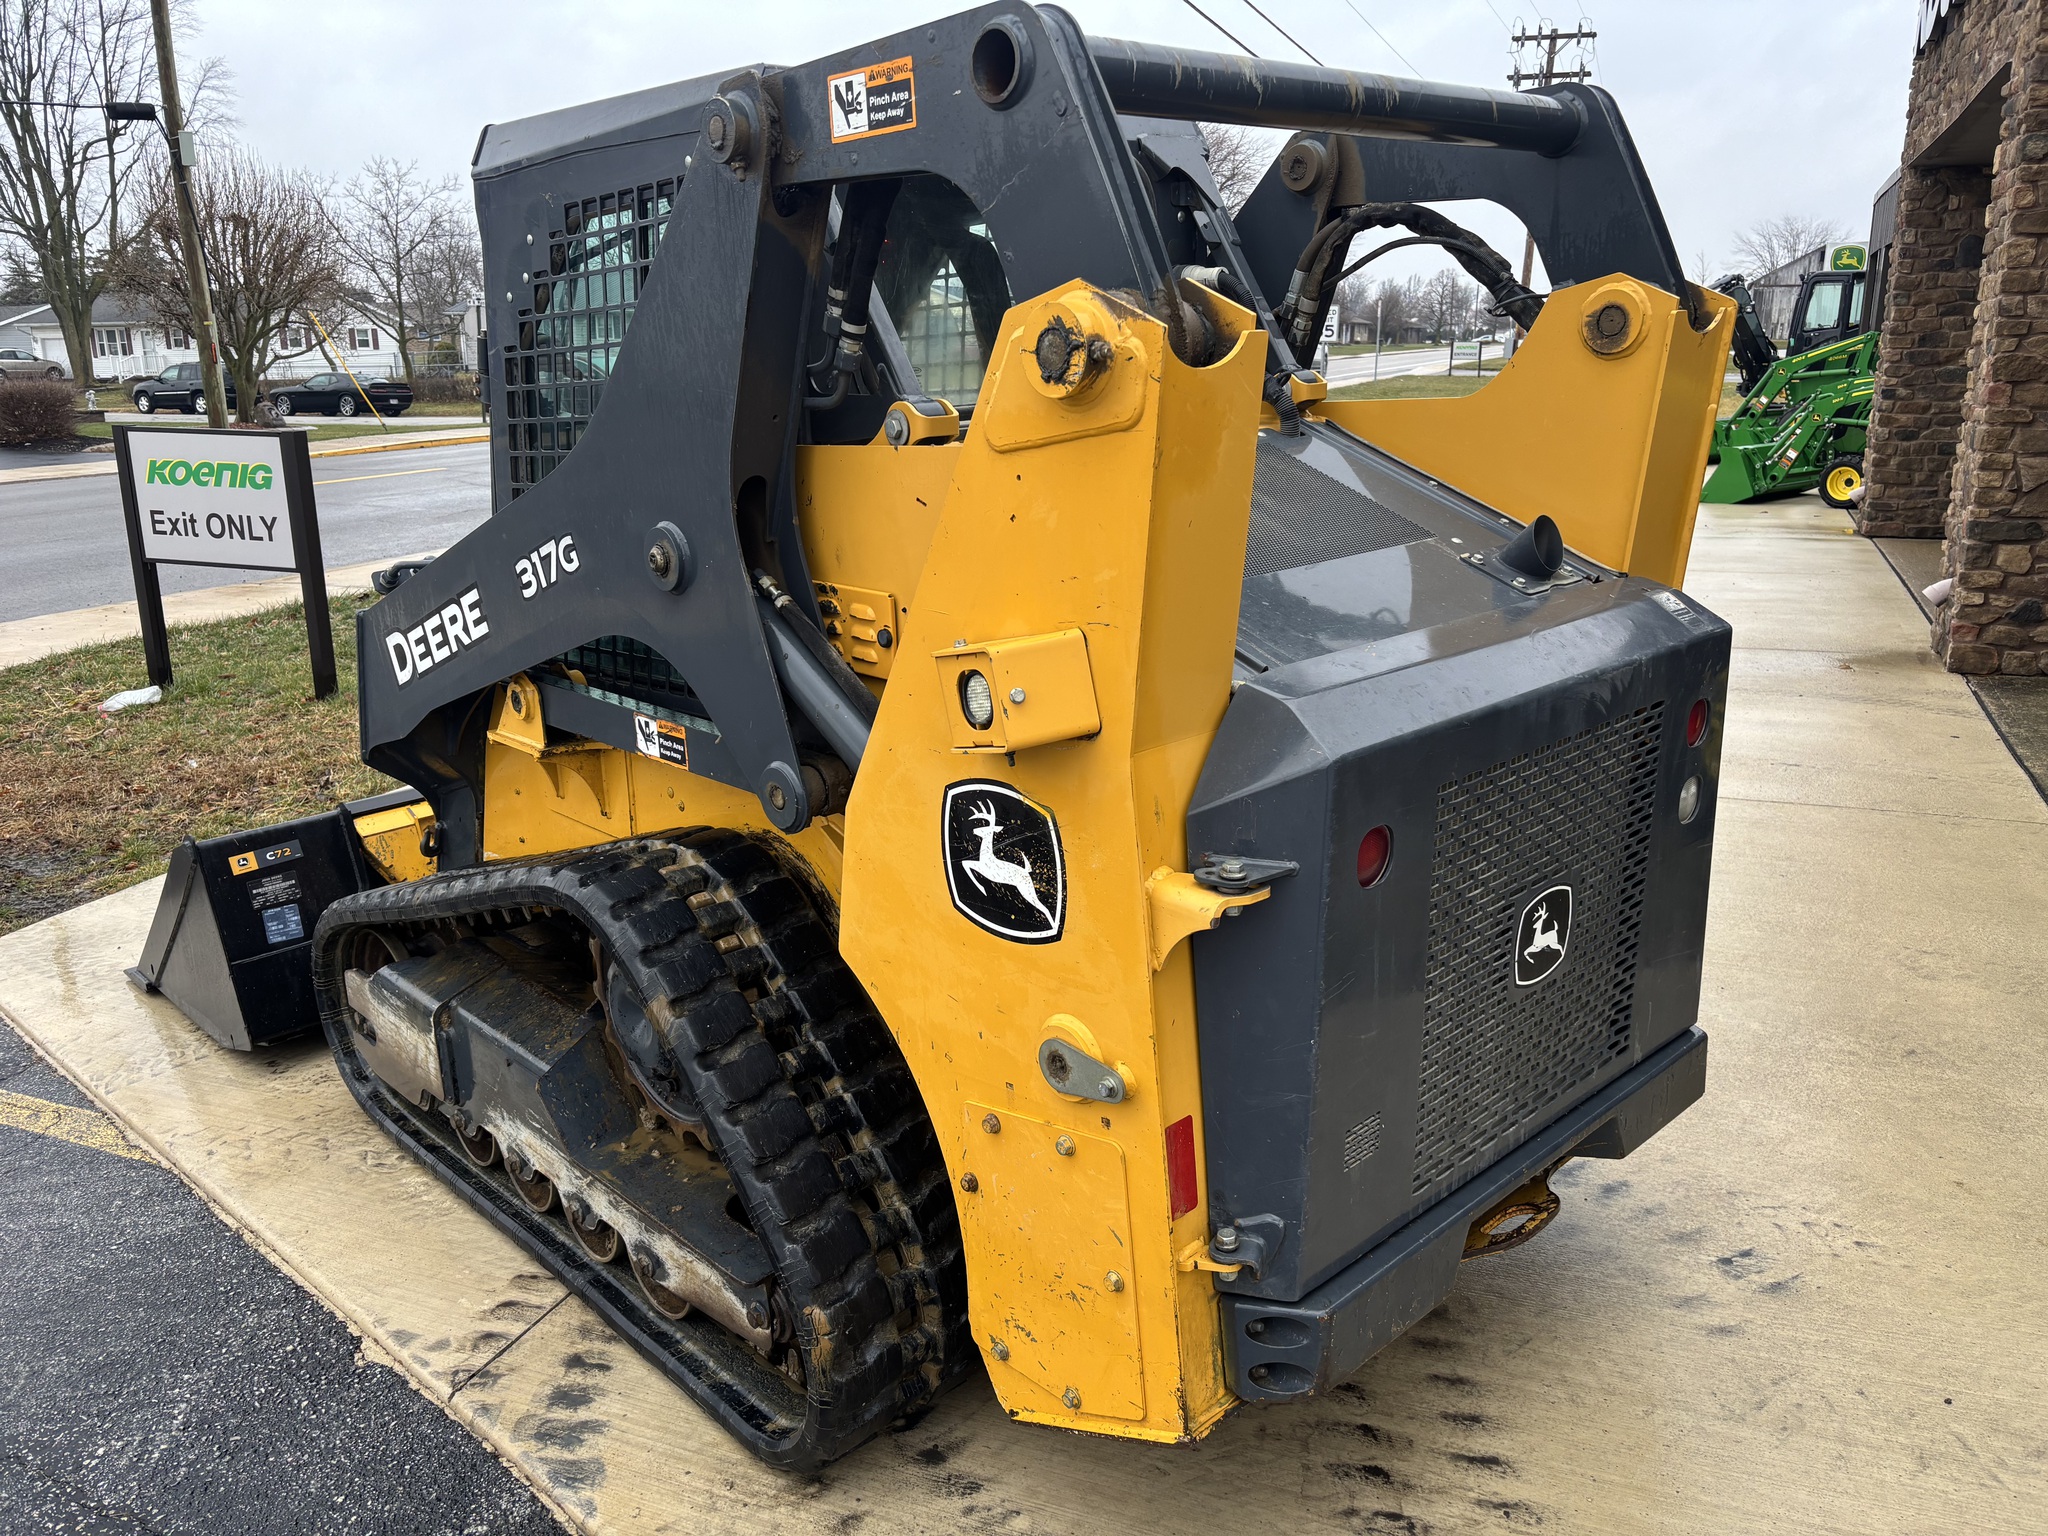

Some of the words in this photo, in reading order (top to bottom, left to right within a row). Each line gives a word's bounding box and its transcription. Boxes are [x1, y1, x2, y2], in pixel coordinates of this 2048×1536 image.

[875, 64, 908, 79] WARNING
[869, 94, 890, 107] Pinch
[891, 91, 909, 101] Area
[870, 112, 886, 121] Keep
[887, 107, 904, 118] Away
[150, 509, 199, 538] Exit
[205, 512, 278, 542] ONLY
[514, 535, 580, 599] 317G
[385, 588, 489, 685] DEERE
[659, 738, 672, 747] Pinch
[673, 742, 684, 751] Area
[266, 847, 292, 860] C72
